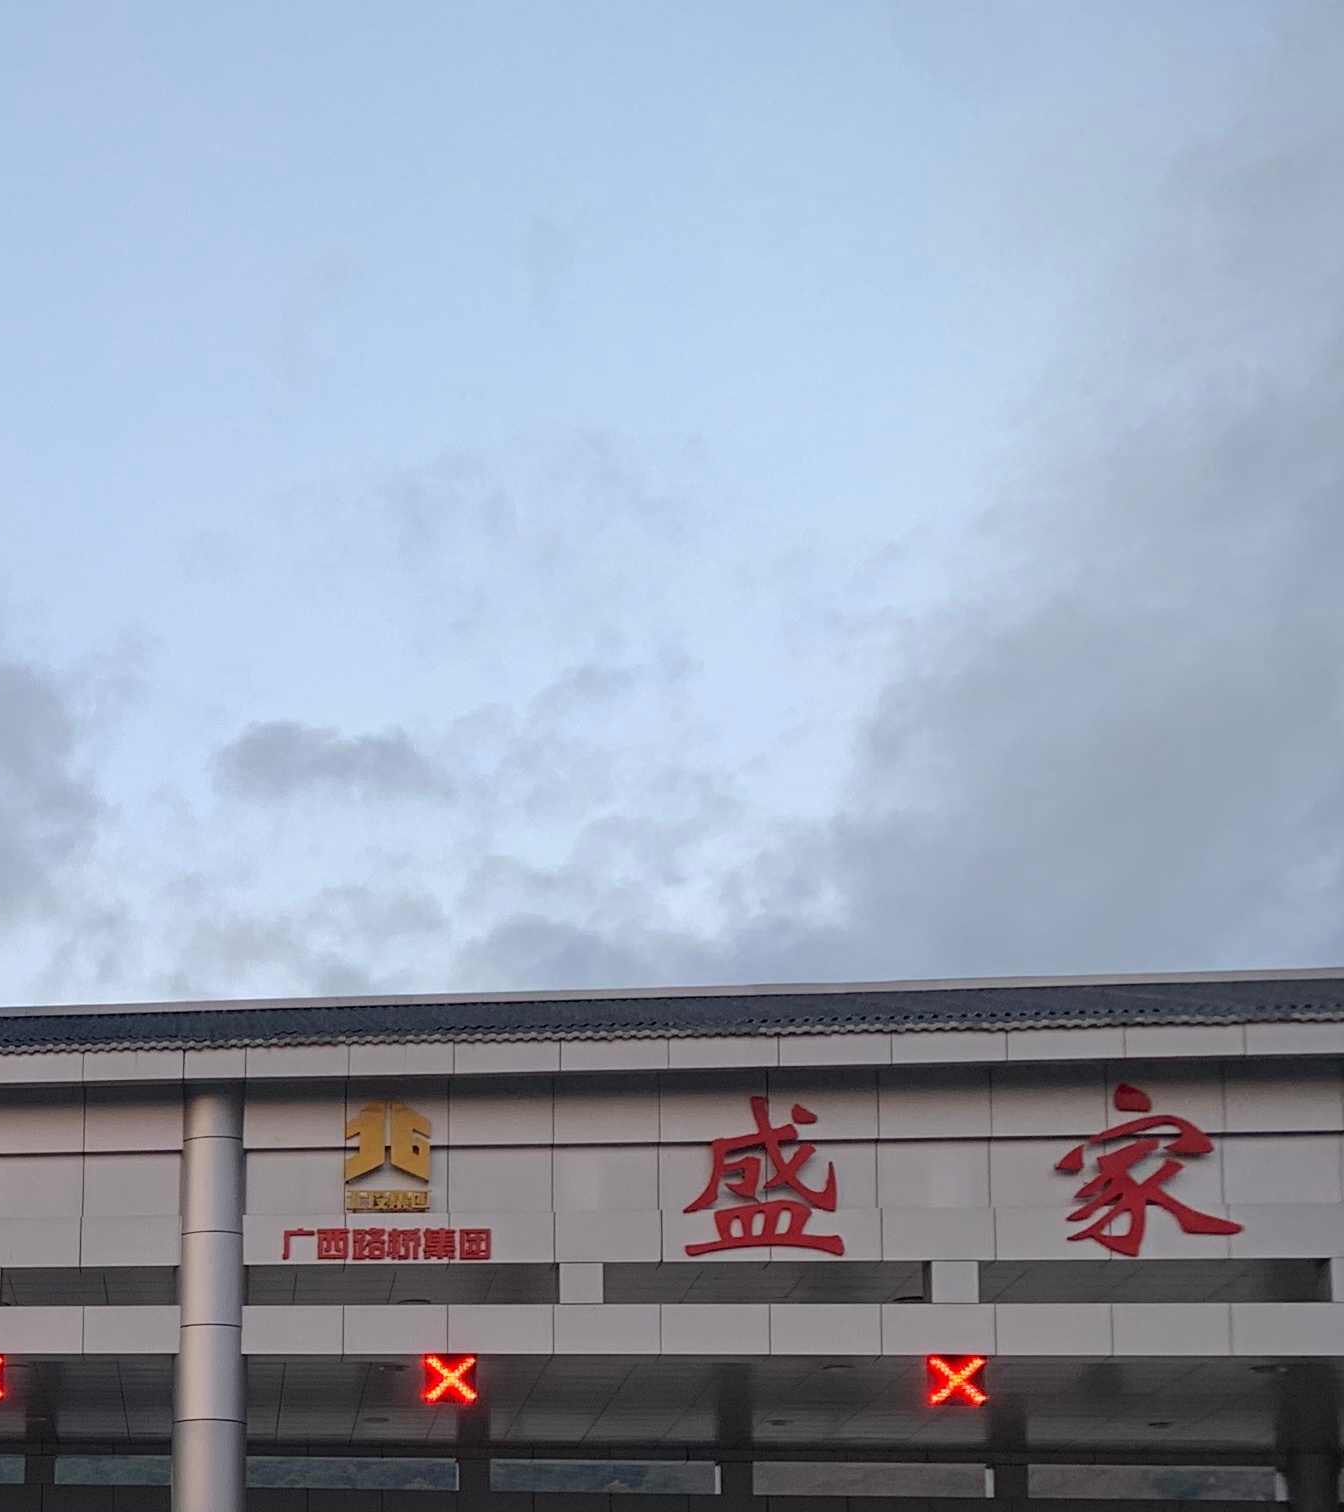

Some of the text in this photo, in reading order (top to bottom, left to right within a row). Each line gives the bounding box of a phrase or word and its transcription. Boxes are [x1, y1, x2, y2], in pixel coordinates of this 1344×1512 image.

[683, 1084, 1244, 1257] 盛家
[283, 1228, 492, 1260] 广西路桥集团
